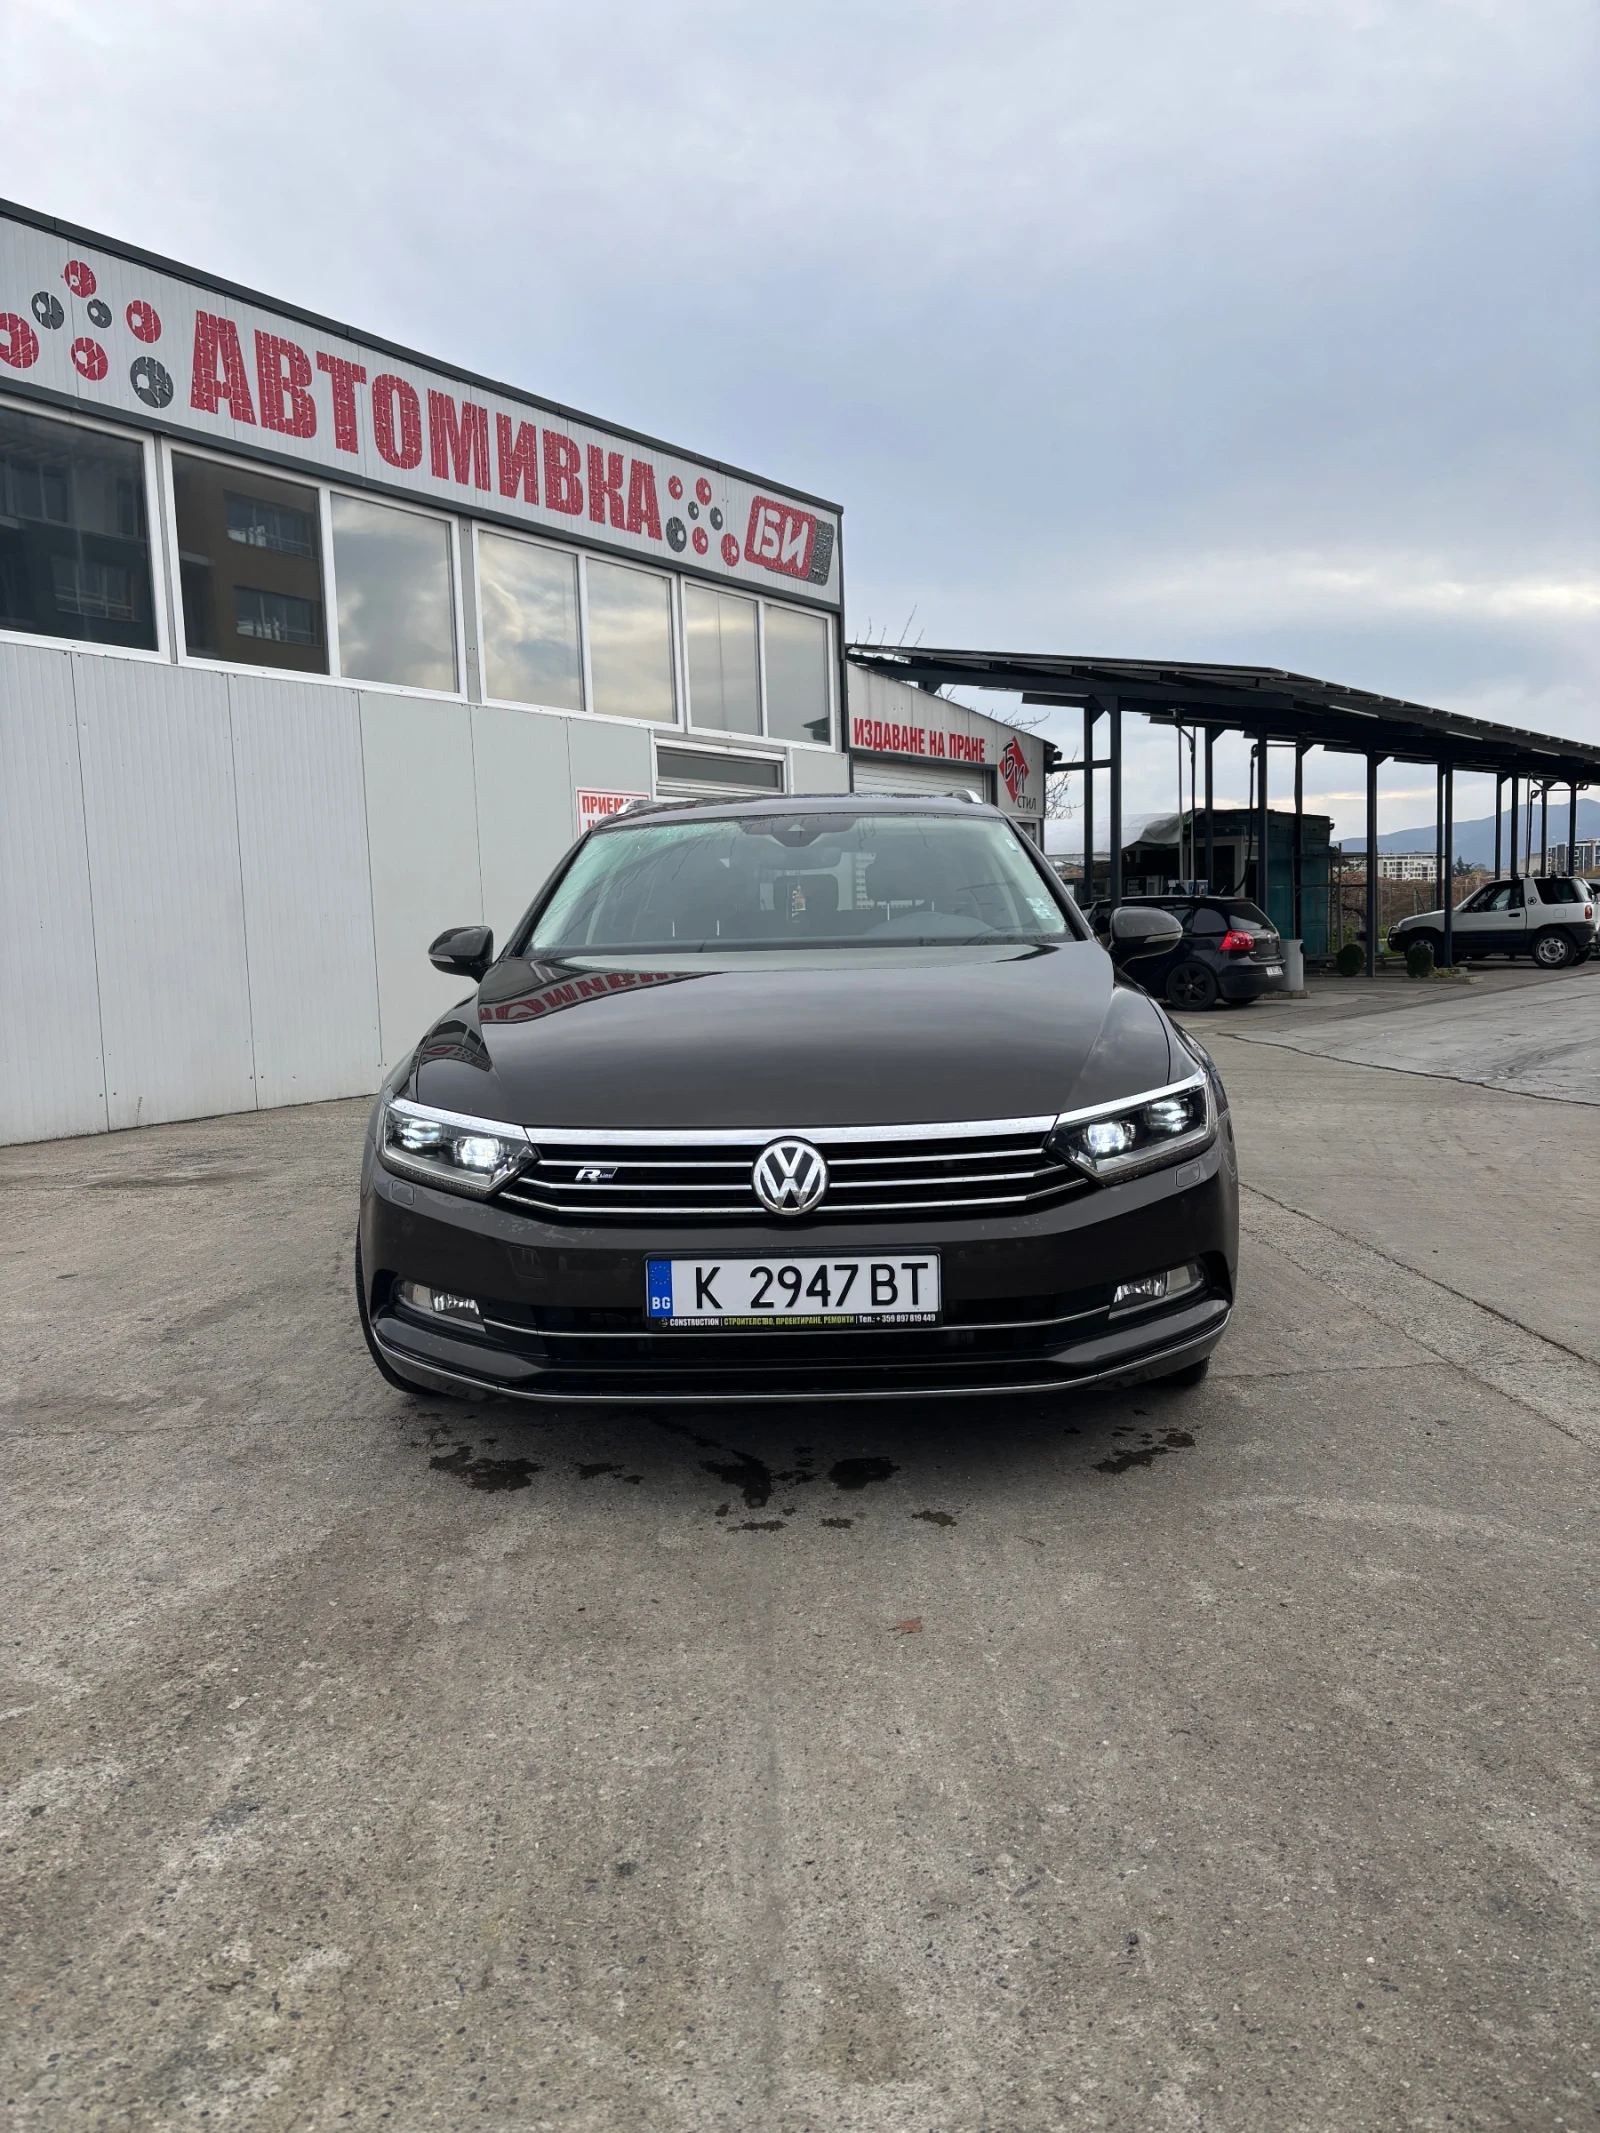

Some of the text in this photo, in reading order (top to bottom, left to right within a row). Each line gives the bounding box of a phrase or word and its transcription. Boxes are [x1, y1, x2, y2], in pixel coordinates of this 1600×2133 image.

[190, 309, 663, 541] АВТОМИВКА
[853, 717, 985, 763] ИЗДАВАНЕ НА ПРАНЕ
[1016, 795, 1037, 811] СТИЛ
[695, 1262, 929, 1310] K 2947 BT
[651, 1296, 671, 1310] BG
[669, 1318, 719, 1327] CONSTRUCTION
